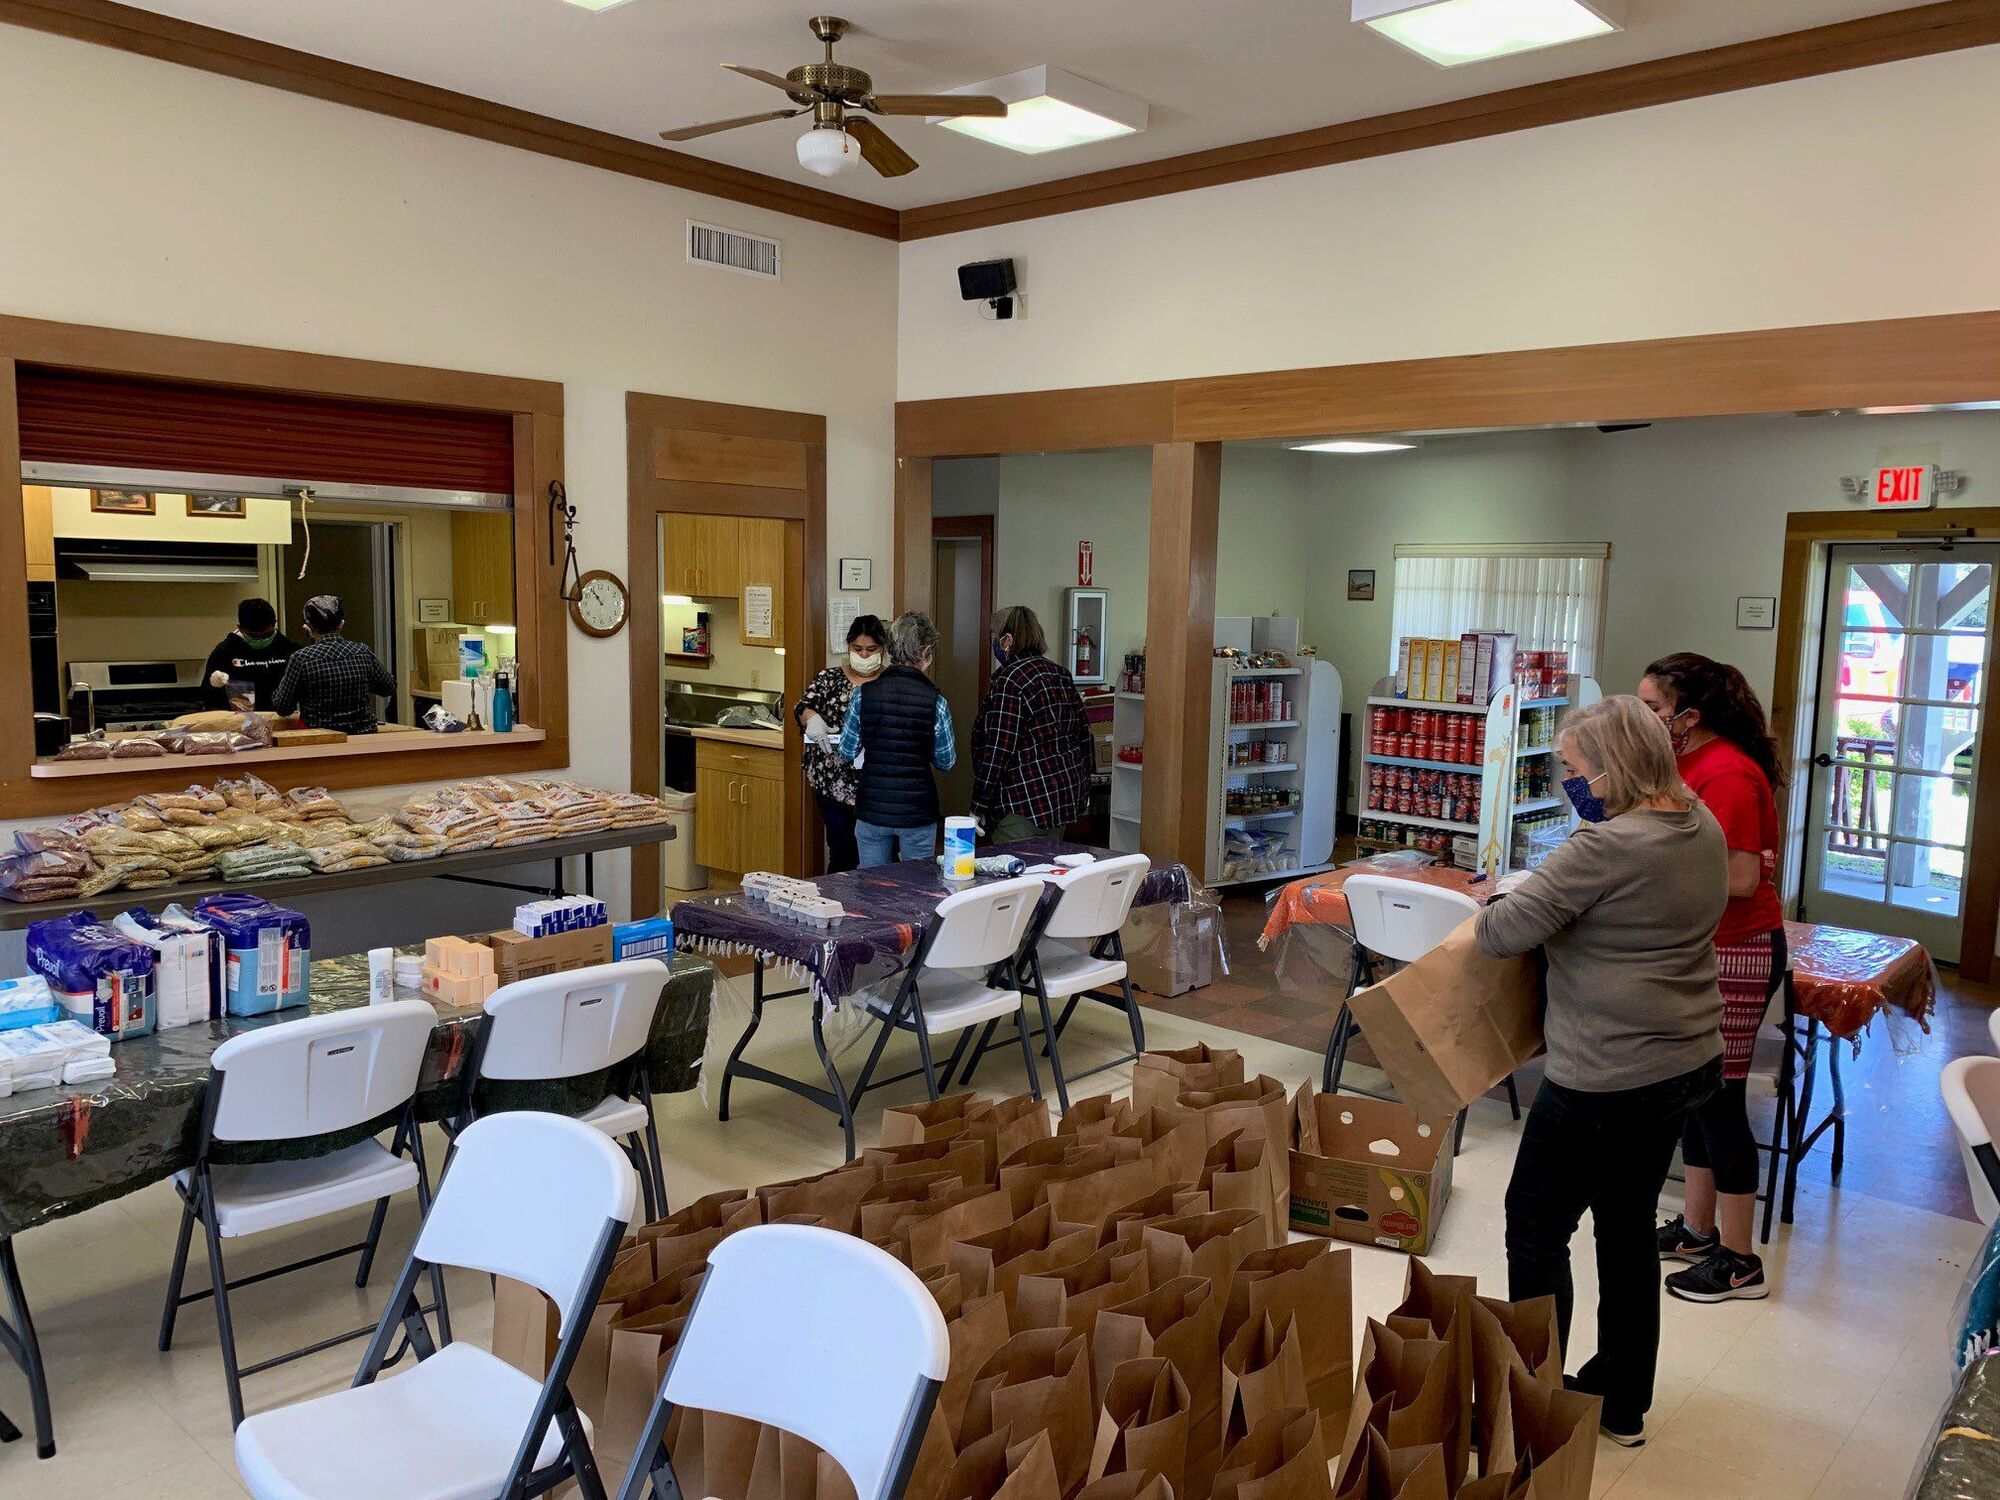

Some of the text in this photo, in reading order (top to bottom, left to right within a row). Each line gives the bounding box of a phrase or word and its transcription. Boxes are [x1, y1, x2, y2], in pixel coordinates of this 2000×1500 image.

[1877, 468, 1924, 503] EXIT
[231, 657, 286, 668] Champion
[36, 947, 60, 978] Prevail
[95, 1006, 106, 1033] Prevail
